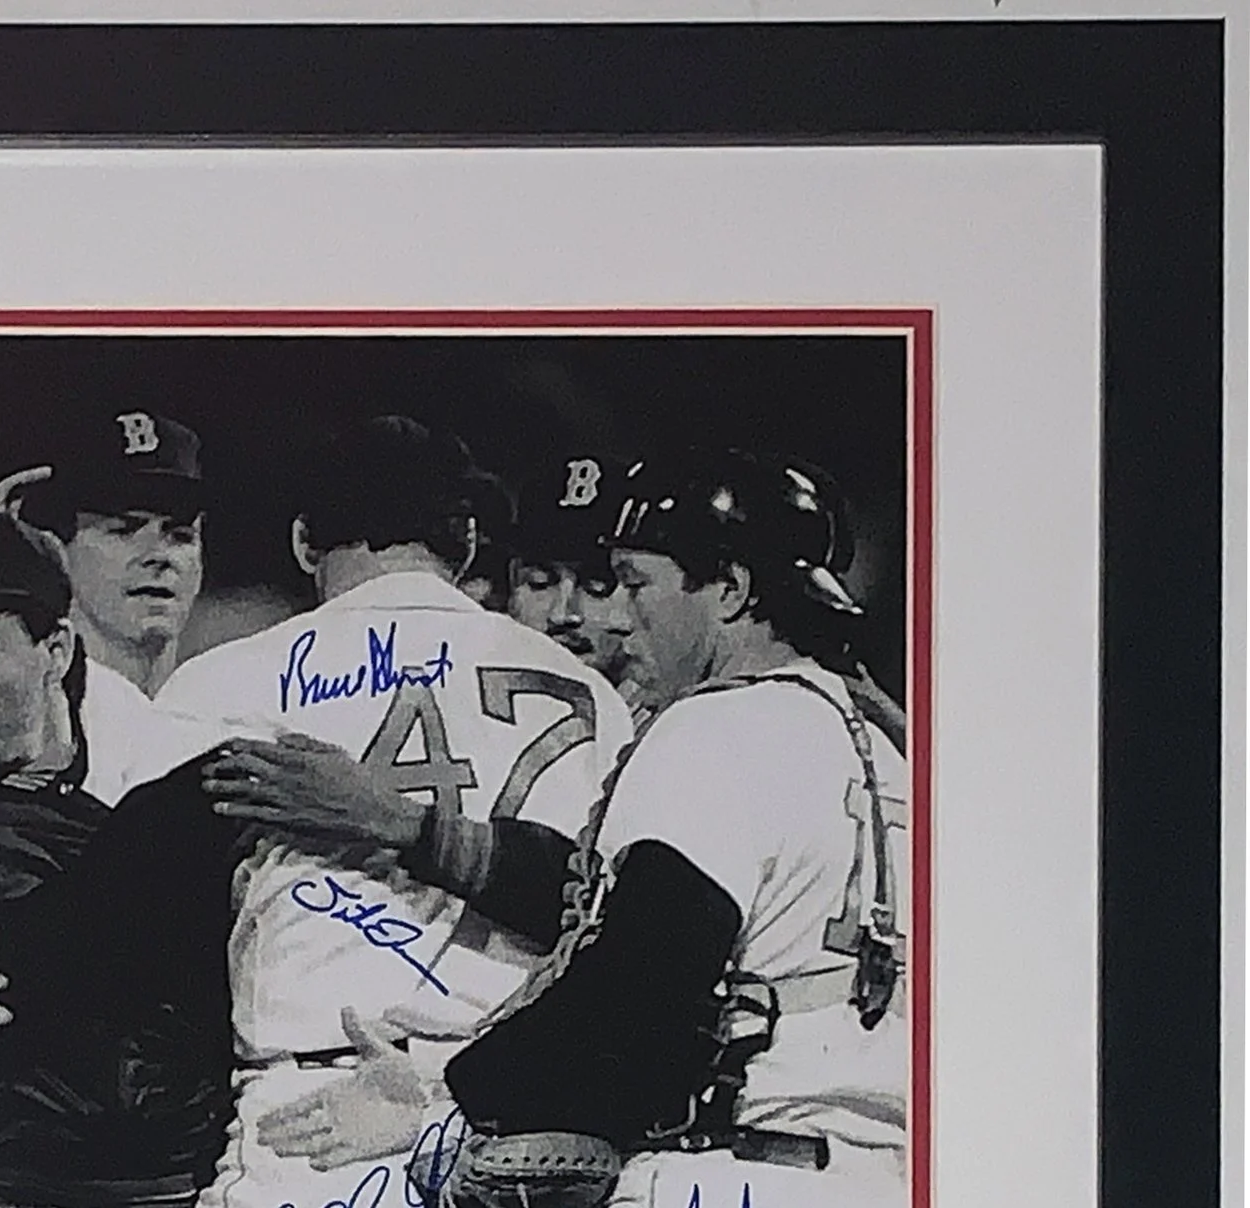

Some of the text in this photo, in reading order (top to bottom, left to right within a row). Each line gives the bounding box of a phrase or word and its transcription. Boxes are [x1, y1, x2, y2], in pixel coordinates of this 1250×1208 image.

[116, 411, 160, 455] B
[559, 459, 601, 506] B
[360, 666, 597, 818] 47
